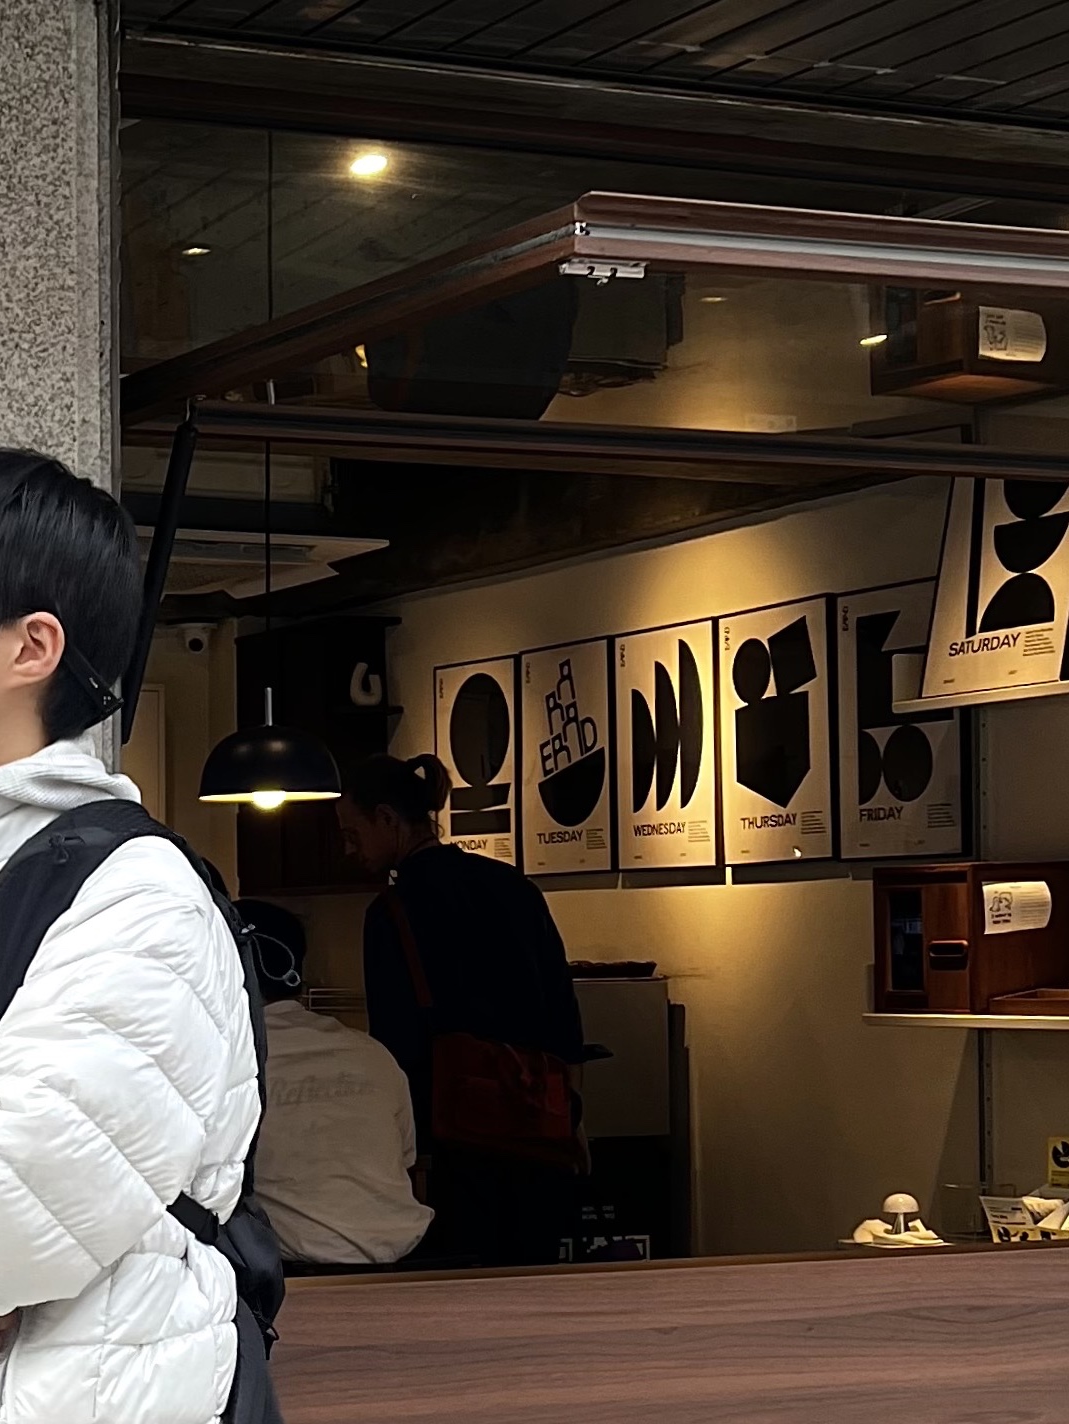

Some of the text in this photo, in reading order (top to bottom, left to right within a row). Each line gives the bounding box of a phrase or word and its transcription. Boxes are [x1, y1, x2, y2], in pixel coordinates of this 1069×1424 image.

[948, 632, 1022, 657] SATURDAY
[740, 812, 798, 830] THURSDAY
[858, 805, 904, 822] FRIDAY
[536, 829, 584, 845] TUESDAY
[633, 821, 687, 837] WEDNESDAY
[449, 839, 488, 851] ONDAY
